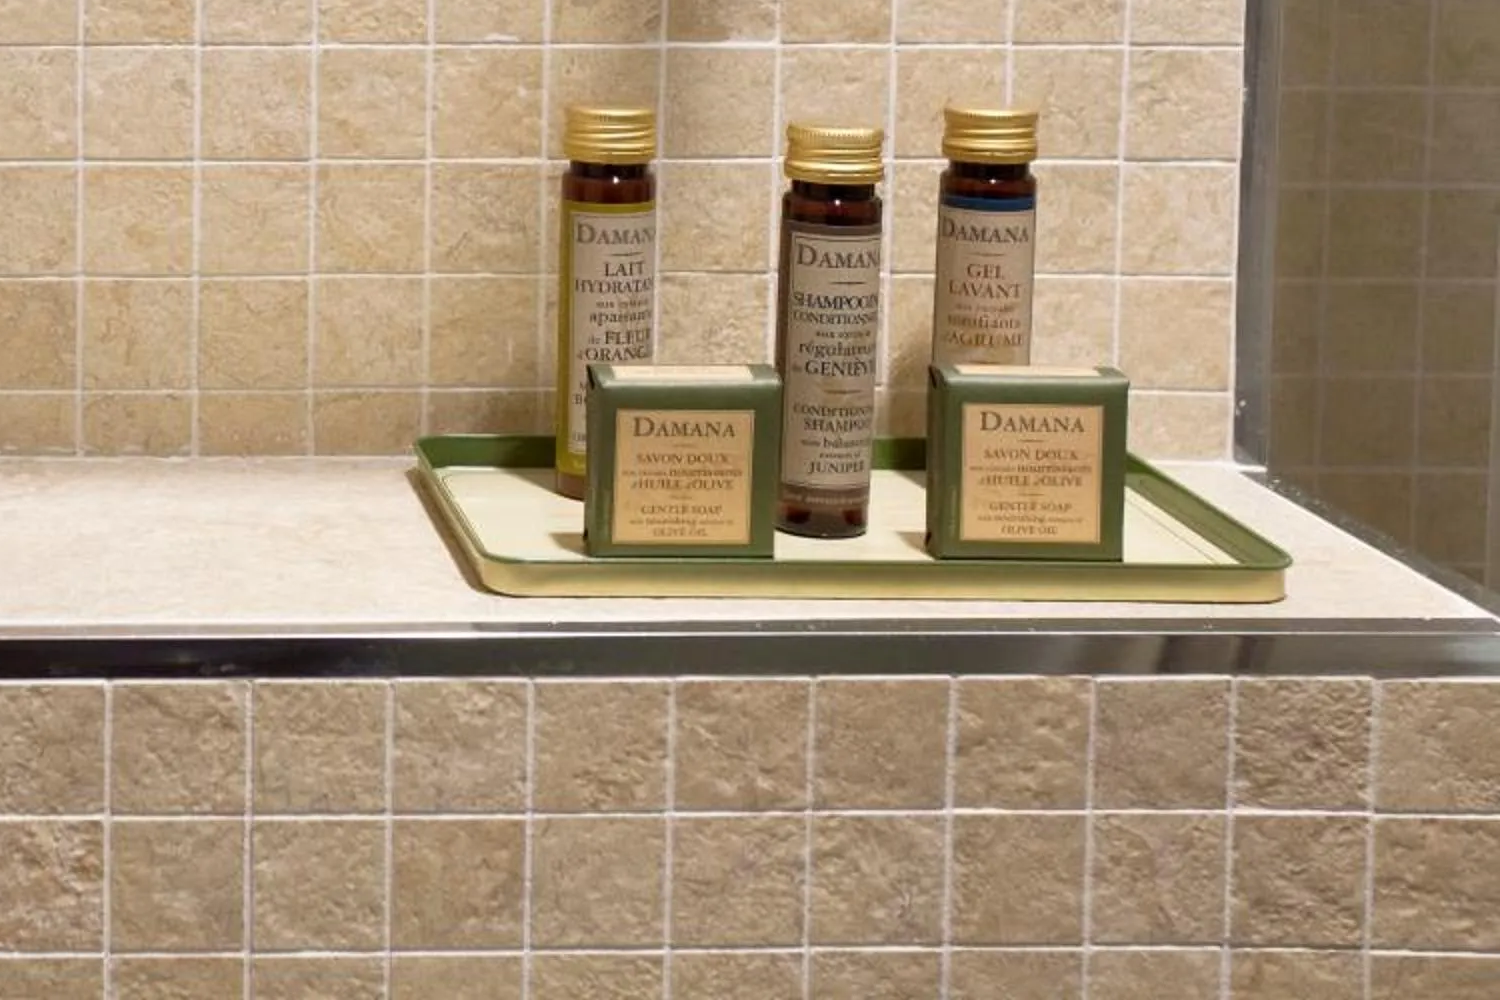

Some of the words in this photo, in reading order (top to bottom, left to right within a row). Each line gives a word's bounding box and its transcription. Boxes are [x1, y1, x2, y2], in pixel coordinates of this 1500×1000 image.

[942, 216, 1029, 243] DAMANA
[604, 261, 645, 277] LAIT
[967, 263, 1005, 279] GEL
[949, 279, 1022, 299] LAVANT
[633, 416, 736, 438] DAMANA
[980, 411, 1085, 433] DAMANA
[636, 453, 682, 464] SAVON
[984, 449, 1030, 460] SAVON
[691, 503, 723, 516] SOAP
[1041, 501, 1073, 513] SOAP
